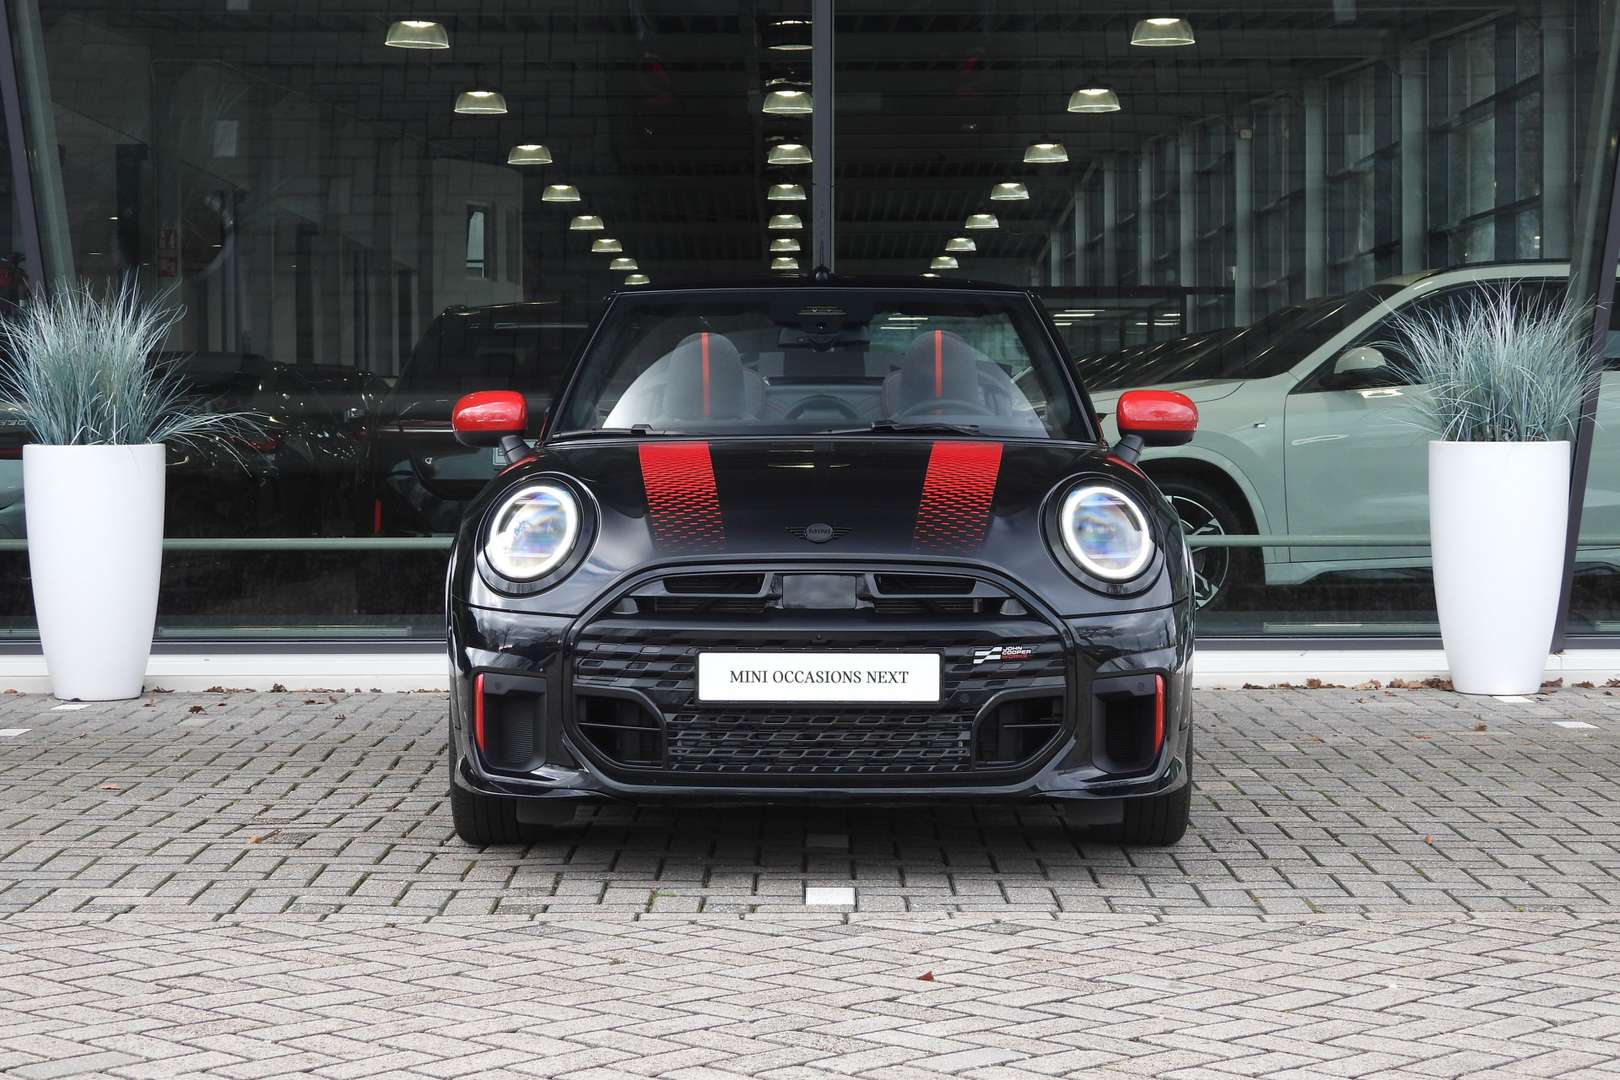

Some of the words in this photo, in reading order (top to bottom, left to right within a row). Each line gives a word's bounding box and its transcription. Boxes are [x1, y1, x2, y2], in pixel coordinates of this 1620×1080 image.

[729, 670, 768, 684] MINI
[772, 670, 862, 684] OCCASIONS
[866, 670, 909, 684] NEXT
